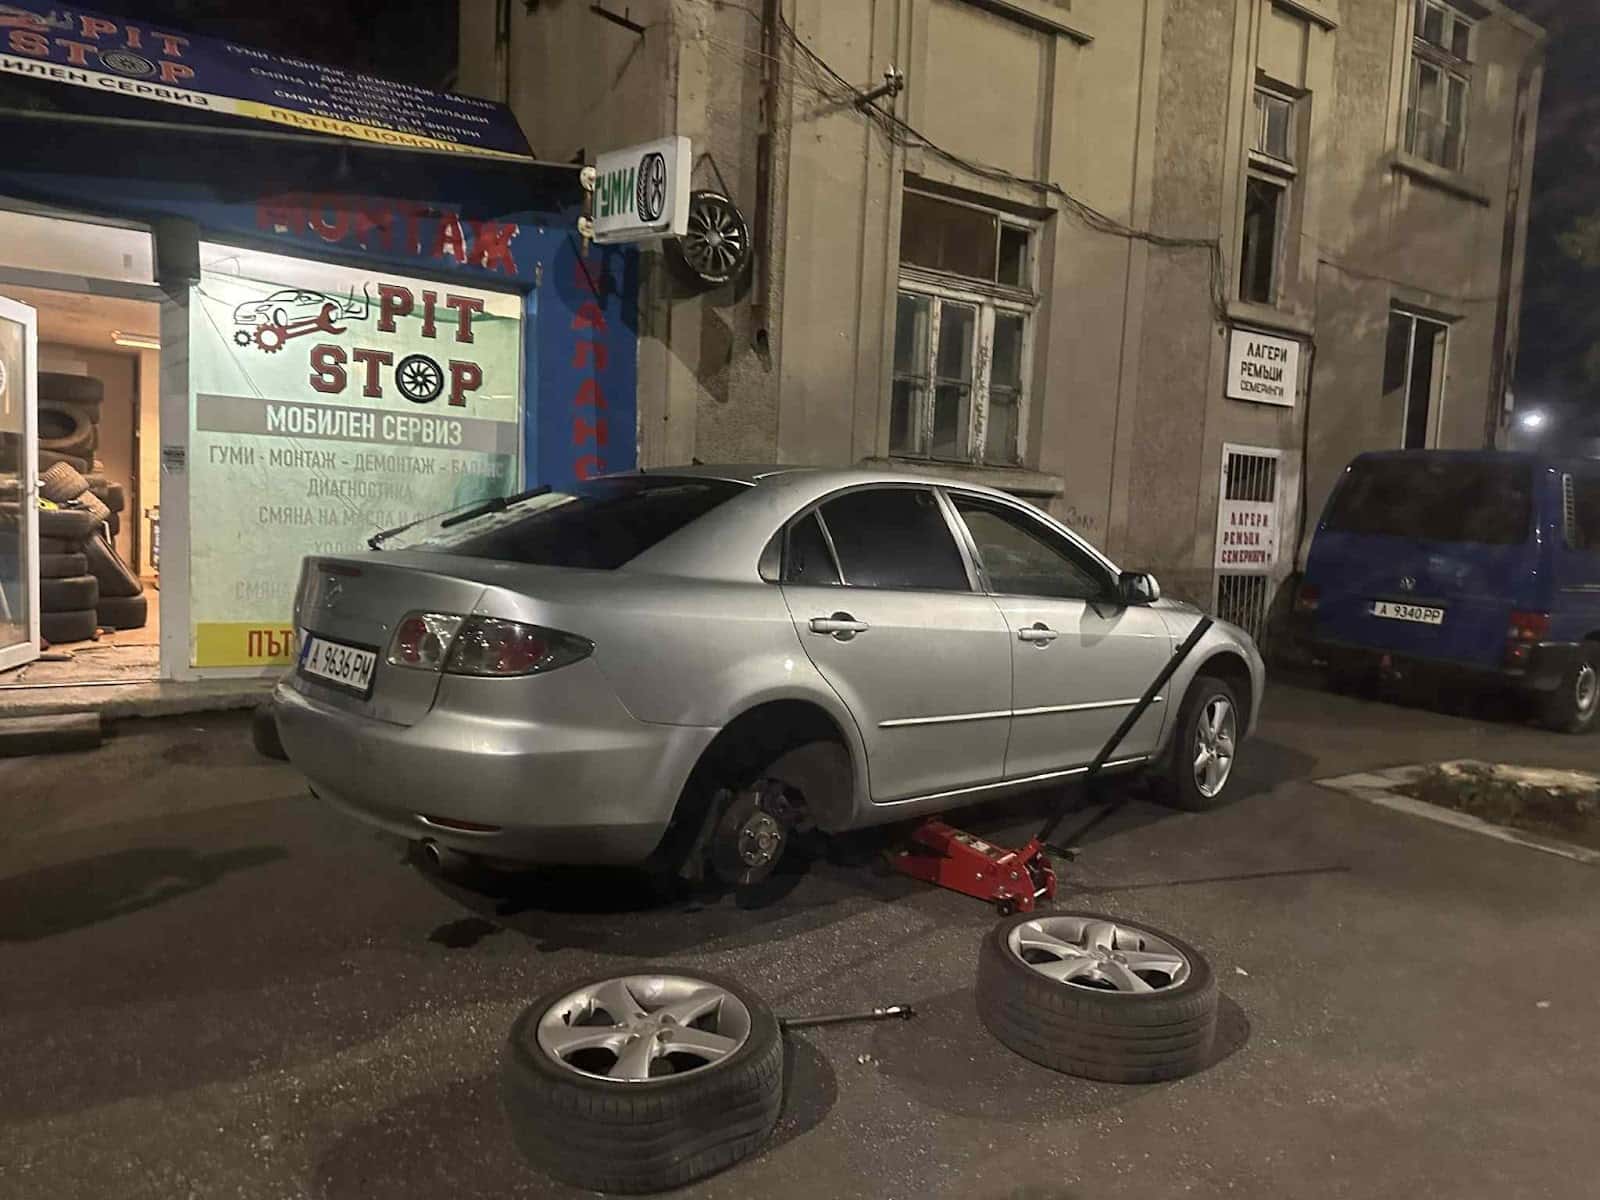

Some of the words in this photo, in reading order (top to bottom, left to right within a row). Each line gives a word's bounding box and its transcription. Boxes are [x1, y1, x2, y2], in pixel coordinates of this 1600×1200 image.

[79, 15, 190, 57] PIT
[98, 77, 209, 106] СЕРВИЗ
[271, 109, 358, 136] ПЪТНА
[593, 167, 634, 219] ГУМИ
[377, 282, 485, 344] PIT
[266, 404, 375, 439] МОБИЛЕН
[382, 415, 463, 446] СЕРВИЗ
[209, 445, 255, 467] ГУМИ
[269, 450, 337, 470] МОНТАЖ
[353, 453, 436, 475] ДЕМОНТАЖ
[306, 477, 413, 500] ДИАГНОСТИКА
[258, 506, 313, 527] СМЯНА
[319, 508, 339, 527] НА
